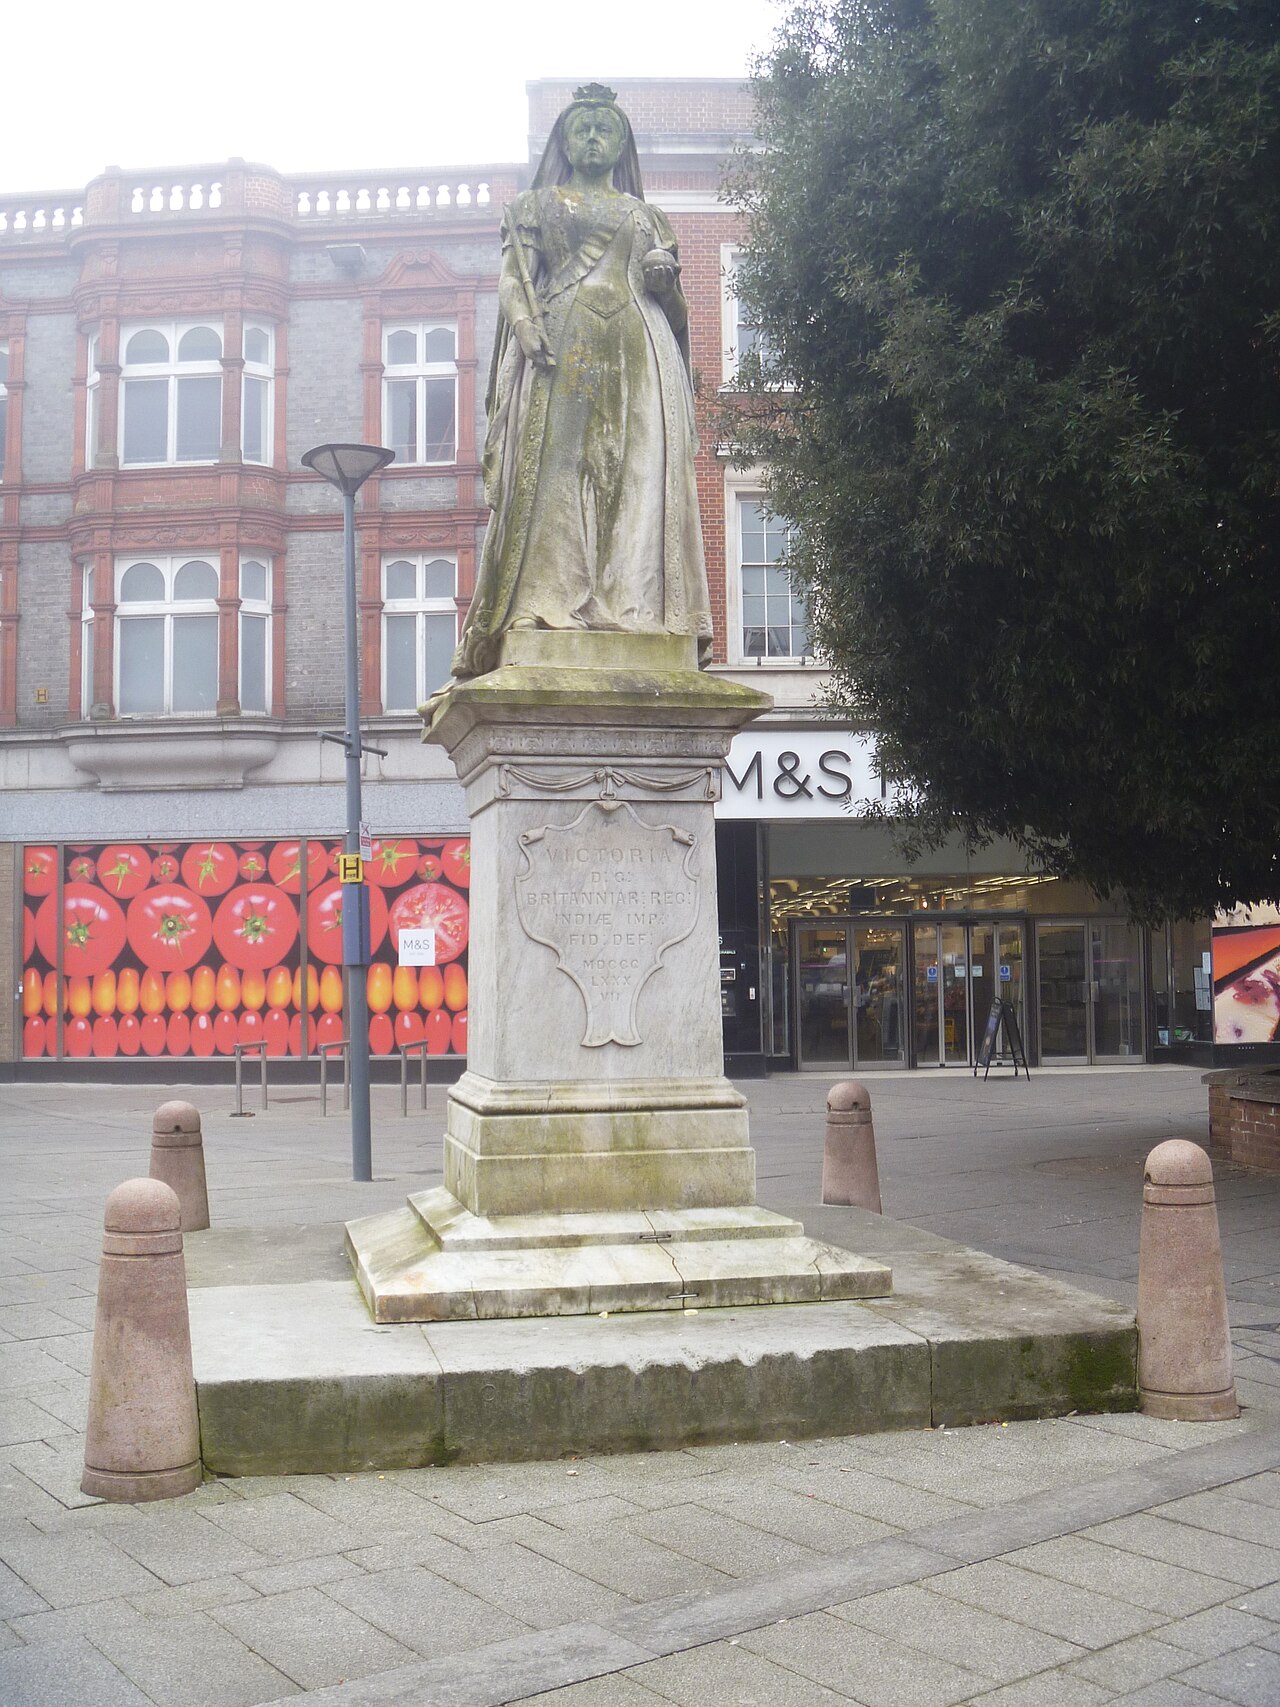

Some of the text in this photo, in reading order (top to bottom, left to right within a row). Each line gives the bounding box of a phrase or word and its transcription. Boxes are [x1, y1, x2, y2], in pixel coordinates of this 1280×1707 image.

[724, 749, 853, 799] M&S
[545, 848, 672, 863] VICTORIA
[343, 857, 359, 879] H
[403, 939, 430, 950] M&S
